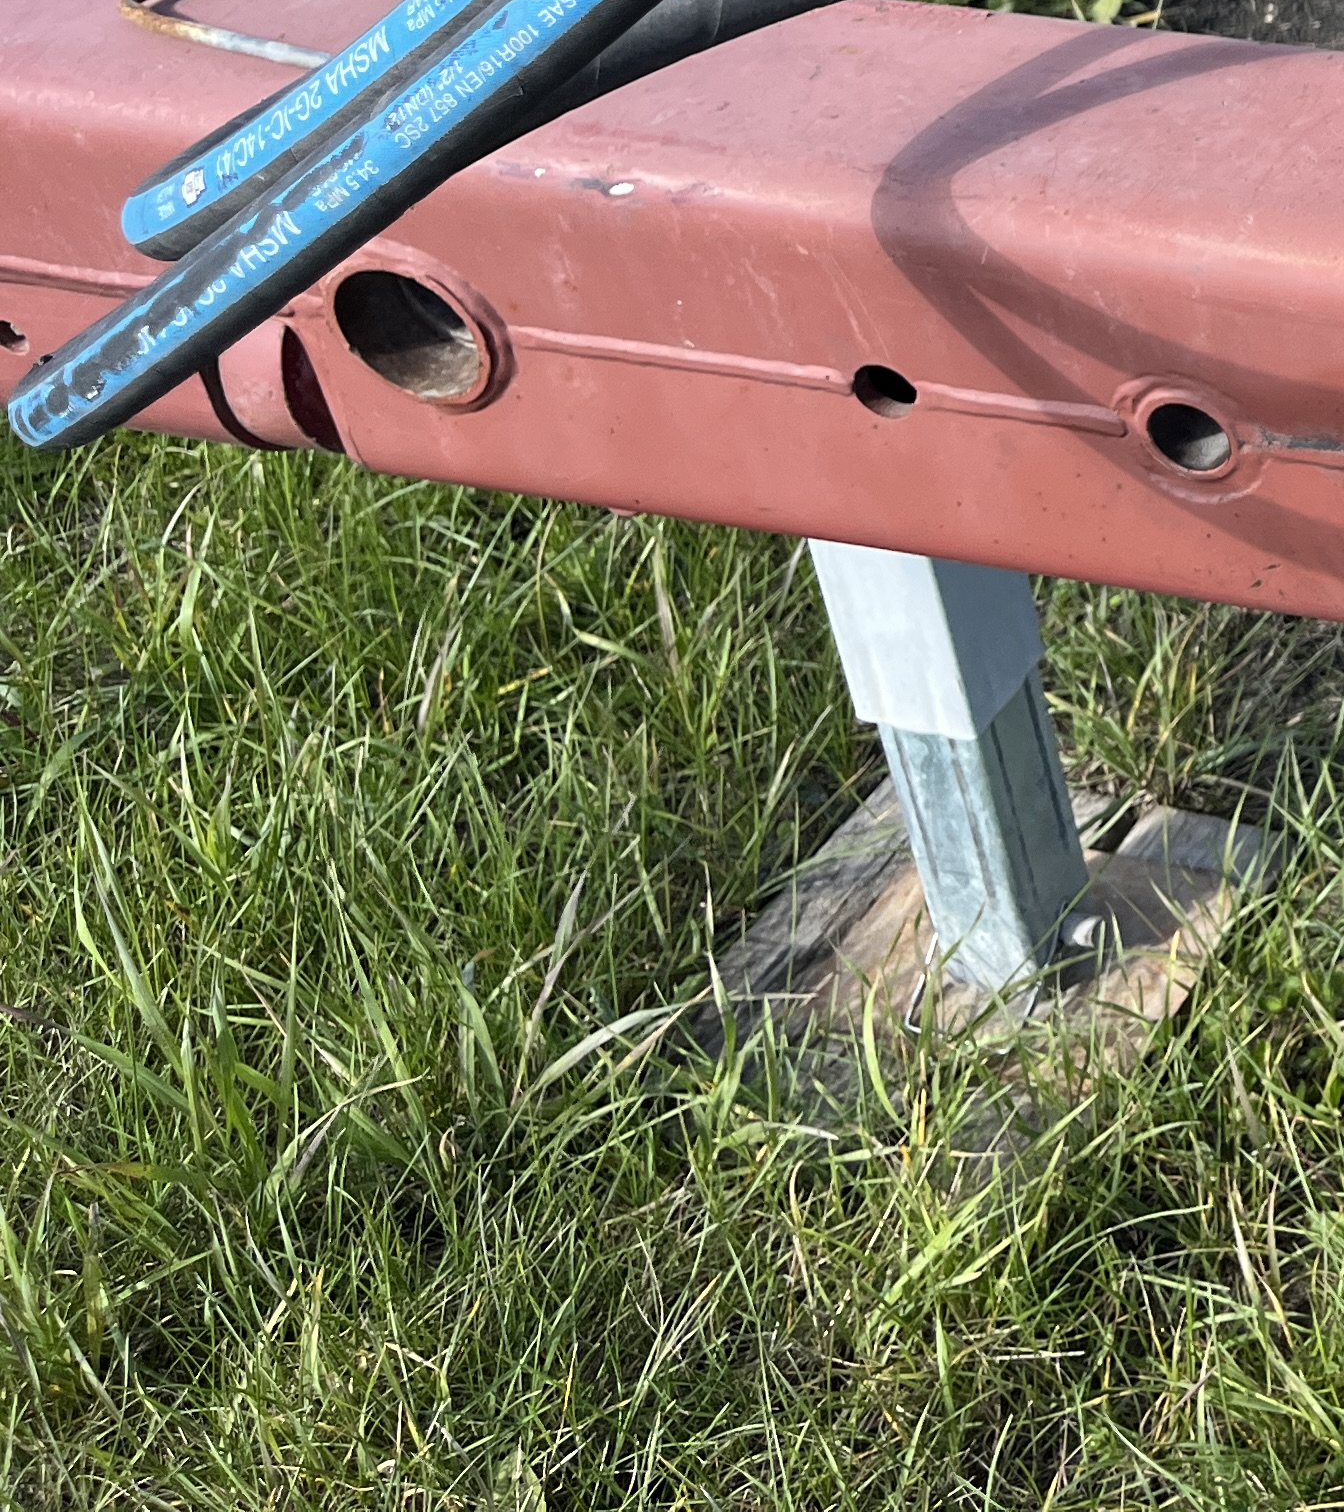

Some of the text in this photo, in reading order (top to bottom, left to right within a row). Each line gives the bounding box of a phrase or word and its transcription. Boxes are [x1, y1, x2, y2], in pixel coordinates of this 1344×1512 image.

[404, 2, 436, 32] MPa
[324, 24, 390, 95] MSHA
[453, 22, 539, 98] 100R16/EN
[427, 91, 458, 123] 857
[390, 114, 430, 149] 2SC
[344, 158, 380, 191] 34.5
[313, 182, 351, 212] MPa
